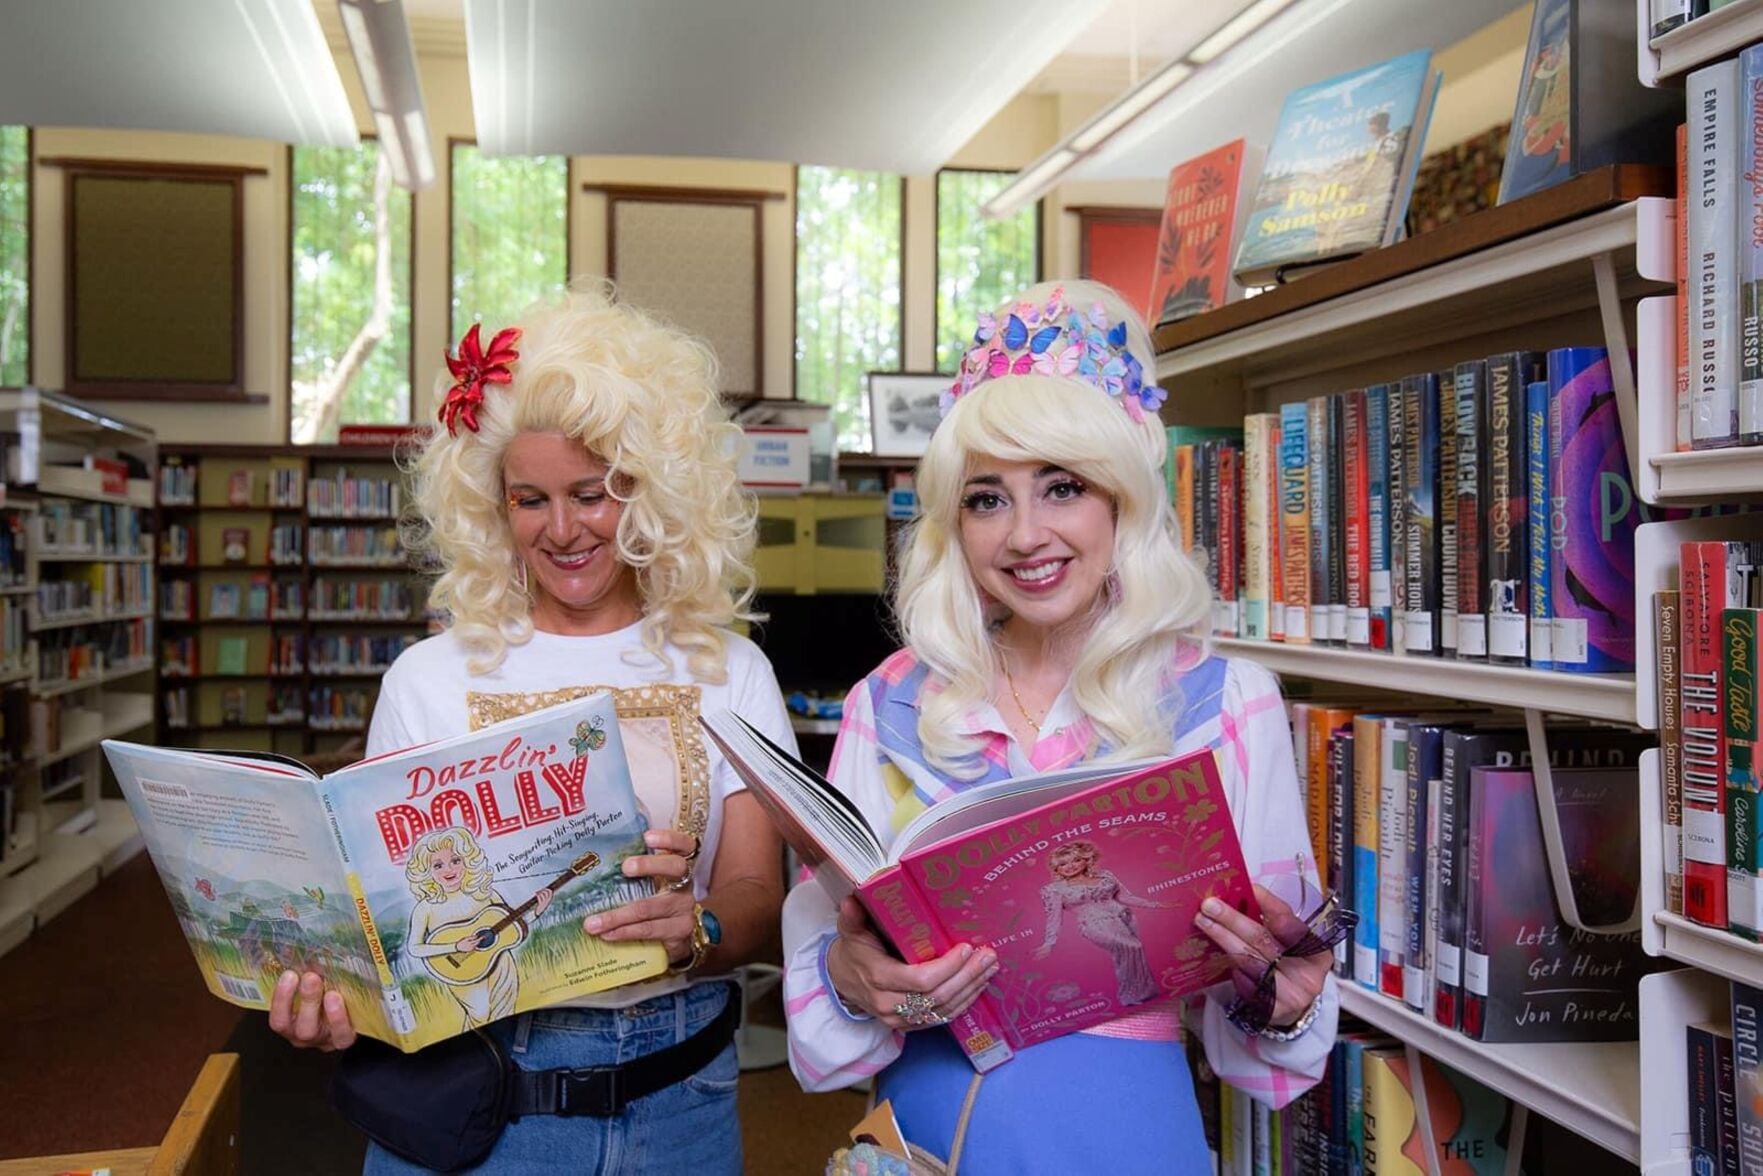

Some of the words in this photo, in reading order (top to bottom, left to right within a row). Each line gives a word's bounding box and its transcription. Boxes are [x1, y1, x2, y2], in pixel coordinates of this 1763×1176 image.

[1704, 88, 1717, 152] EMPIRE
[1284, 181, 1351, 212] Polly
[1703, 158, 1716, 208] FALLS
[1257, 201, 1369, 238] Samson
[1702, 252, 1716, 331] RICHARD
[1703, 339, 1716, 393] RUSS
[1744, 316, 1759, 368] RUSSO
[1390, 393, 1402, 445] JAMES
[1406, 391, 1419, 425] JAMES
[1440, 381, 1455, 432] JAMES
[1491, 365, 1509, 430] JAMES
[1345, 404, 1358, 445] JAMES
[1456, 373, 1478, 495] BLOWBACK
[754, 455, 790, 467] FICTION
[1284, 418, 1305, 514] LIFEGUARD
[1406, 427, 1420, 488] PATTERSON
[1311, 455, 1323, 526] PATTERSON
[1391, 449, 1404, 545] PATTERSON
[1492, 435, 1511, 553] PATTERSON
[1286, 525, 1306, 557] JAMES
[1346, 523, 1360, 547] THE
[1551, 496, 1568, 550] POD
[1347, 553, 1360, 579] RED
[1407, 525, 1421, 578] SUMMER
[1441, 525, 1457, 610] COUNTDOW
[1660, 605, 1675, 643] Seven
[1684, 570, 1694, 646] SCIBONA
[1699, 562, 1710, 657] SALVATORE
[1662, 646, 1677, 689] Empty
[1724, 617, 1754, 672] Good
[1663, 690, 1678, 731] Houses
[1683, 670, 1718, 717] THE
[1728, 675, 1754, 733] Taste
[406, 736, 558, 800] Dazzlin'
[1408, 741, 1419, 781] Jodi
[1443, 748, 1455, 806] BEHIND
[1665, 741, 1680, 797] Samanta
[1683, 727, 1719, 814] VOLUN
[375, 753, 590, 866] DOLLY
[573, 826, 597, 842] Dolly
[595, 809, 624, 830] Parton
[921, 816, 1043, 891] DOLLY
[1051, 759, 1210, 826] PARTON
[1407, 787, 1419, 852] Picoult
[1441, 812, 1453, 843] HER
[1734, 796, 1750, 861] Caroline
[494, 861, 509, 874] The
[983, 839, 1051, 883] BEHIND
[1051, 823, 1094, 844] THE
[1097, 811, 1168, 830] SEAMS
[1440, 849, 1453, 887] EYES
[1147, 859, 1231, 894] RHINESTONES
[1411, 876, 1419, 914] WISH
[356, 897, 375, 938] DAZZLIN'
[369, 936, 386, 965] DOLLY
[991, 934, 1018, 949] LIFE
[1020, 928, 1034, 938] IN
[1411, 922, 1419, 952] YOU
[1515, 924, 1560, 946] Let's
[1569, 927, 1596, 945] No
[596, 958, 618, 970] Slade
[1527, 957, 1563, 981] Get
[1570, 953, 1624, 977] Hurt
[963, 1013, 976, 1028] THE
[1031, 1014, 1062, 1031] DOLLY
[1065, 1000, 1106, 1019] PARTON
[1515, 1000, 1551, 1027] Jon
[1561, 1001, 1635, 1024] Pineda
[1735, 1003, 1760, 1084] CIRCLE
[1441, 1139, 1486, 1161] THE
